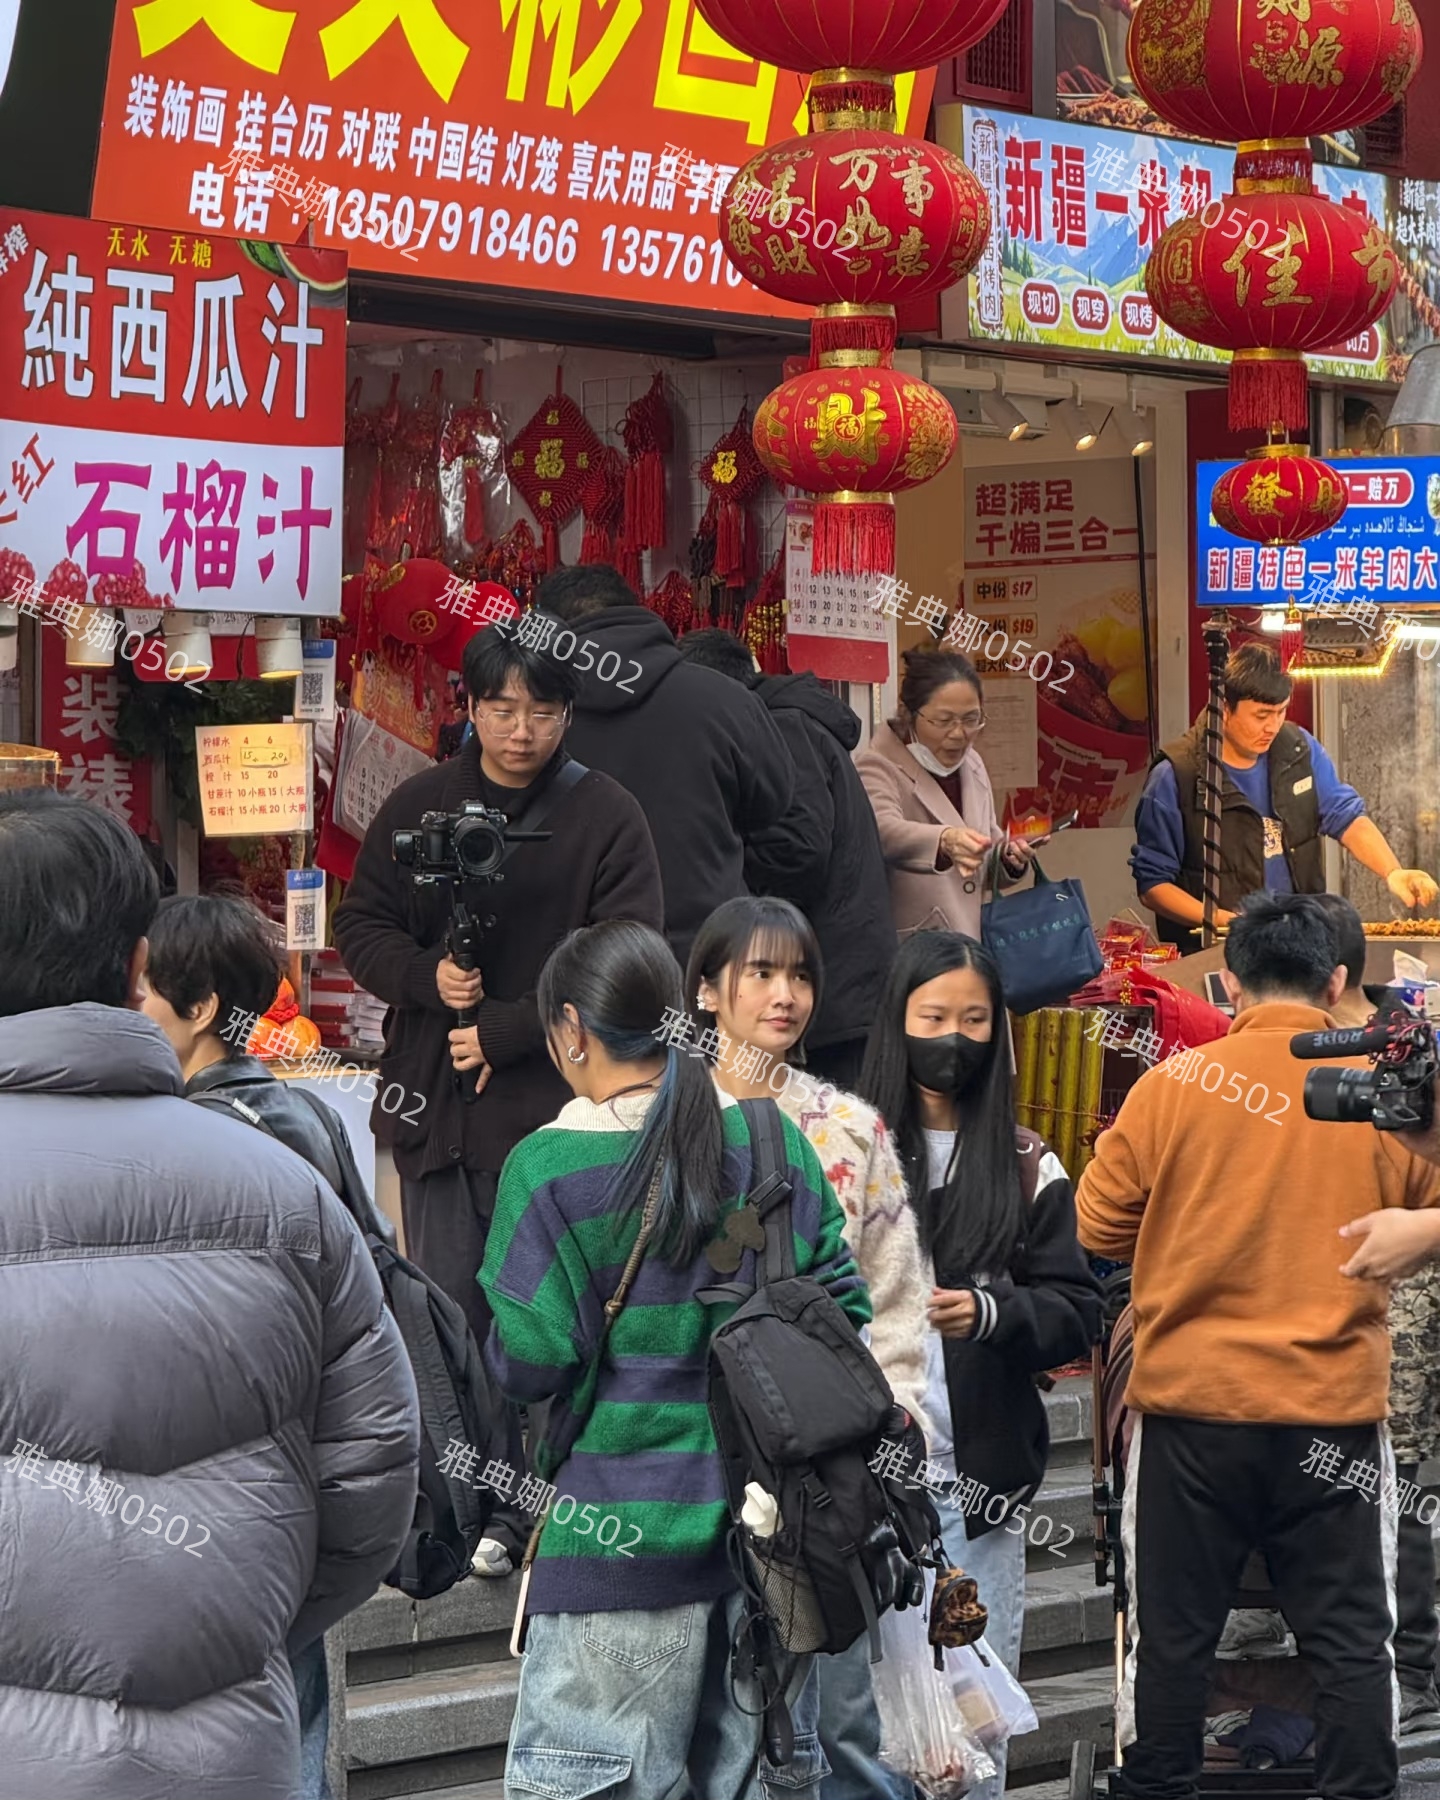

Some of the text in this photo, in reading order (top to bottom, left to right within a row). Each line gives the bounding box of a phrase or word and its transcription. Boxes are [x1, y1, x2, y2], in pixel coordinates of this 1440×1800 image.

[124, 73, 228, 149] 装饰画
[235, 89, 334, 160] 挂台历
[337, 109, 403, 172] 对联
[408, 116, 499, 186] 中国结
[501, 130, 563, 196] 灯笼
[568, 141, 676, 213] 喜庆用品
[1403, 176, 1440, 213] 新疆一
[322, 186, 580, 269] 13507918466
[1396, 210, 1440, 249] 超大羊肉
[107, 227, 212, 268] 无水 无糖
[1027, 290, 1056, 317] 现切
[1077, 295, 1106, 323] 现穿
[1125, 302, 1152, 328] 现烤
[21, 248, 325, 418] 純西瓜汁
[976, 479, 1074, 517] 超满足
[1343, 476, 1400, 501] 一赔万
[66, 459, 333, 600] 石榴汁
[976, 516, 1139, 556] 干煸三合一
[809, 584, 817, 594] 12
[823, 586, 831, 595] 13
[837, 588, 844, 596] 14
[850, 589, 857, 598] 15
[977, 581, 1033, 599] 中份 $17
[809, 600, 817, 608] 19
[823, 601, 831, 610] 20
[837, 602, 844, 611] 21
[850, 604, 857, 613] 22
[808, 615, 817, 624] 26
[823, 616, 831, 625] 27
[837, 617, 844, 626] 28
[1012, 618, 1034, 634] $19
[243, 736, 249, 744] 4
[267, 736, 273, 744] 6
[241, 771, 250, 780] 15
[267, 770, 278, 779] 20
